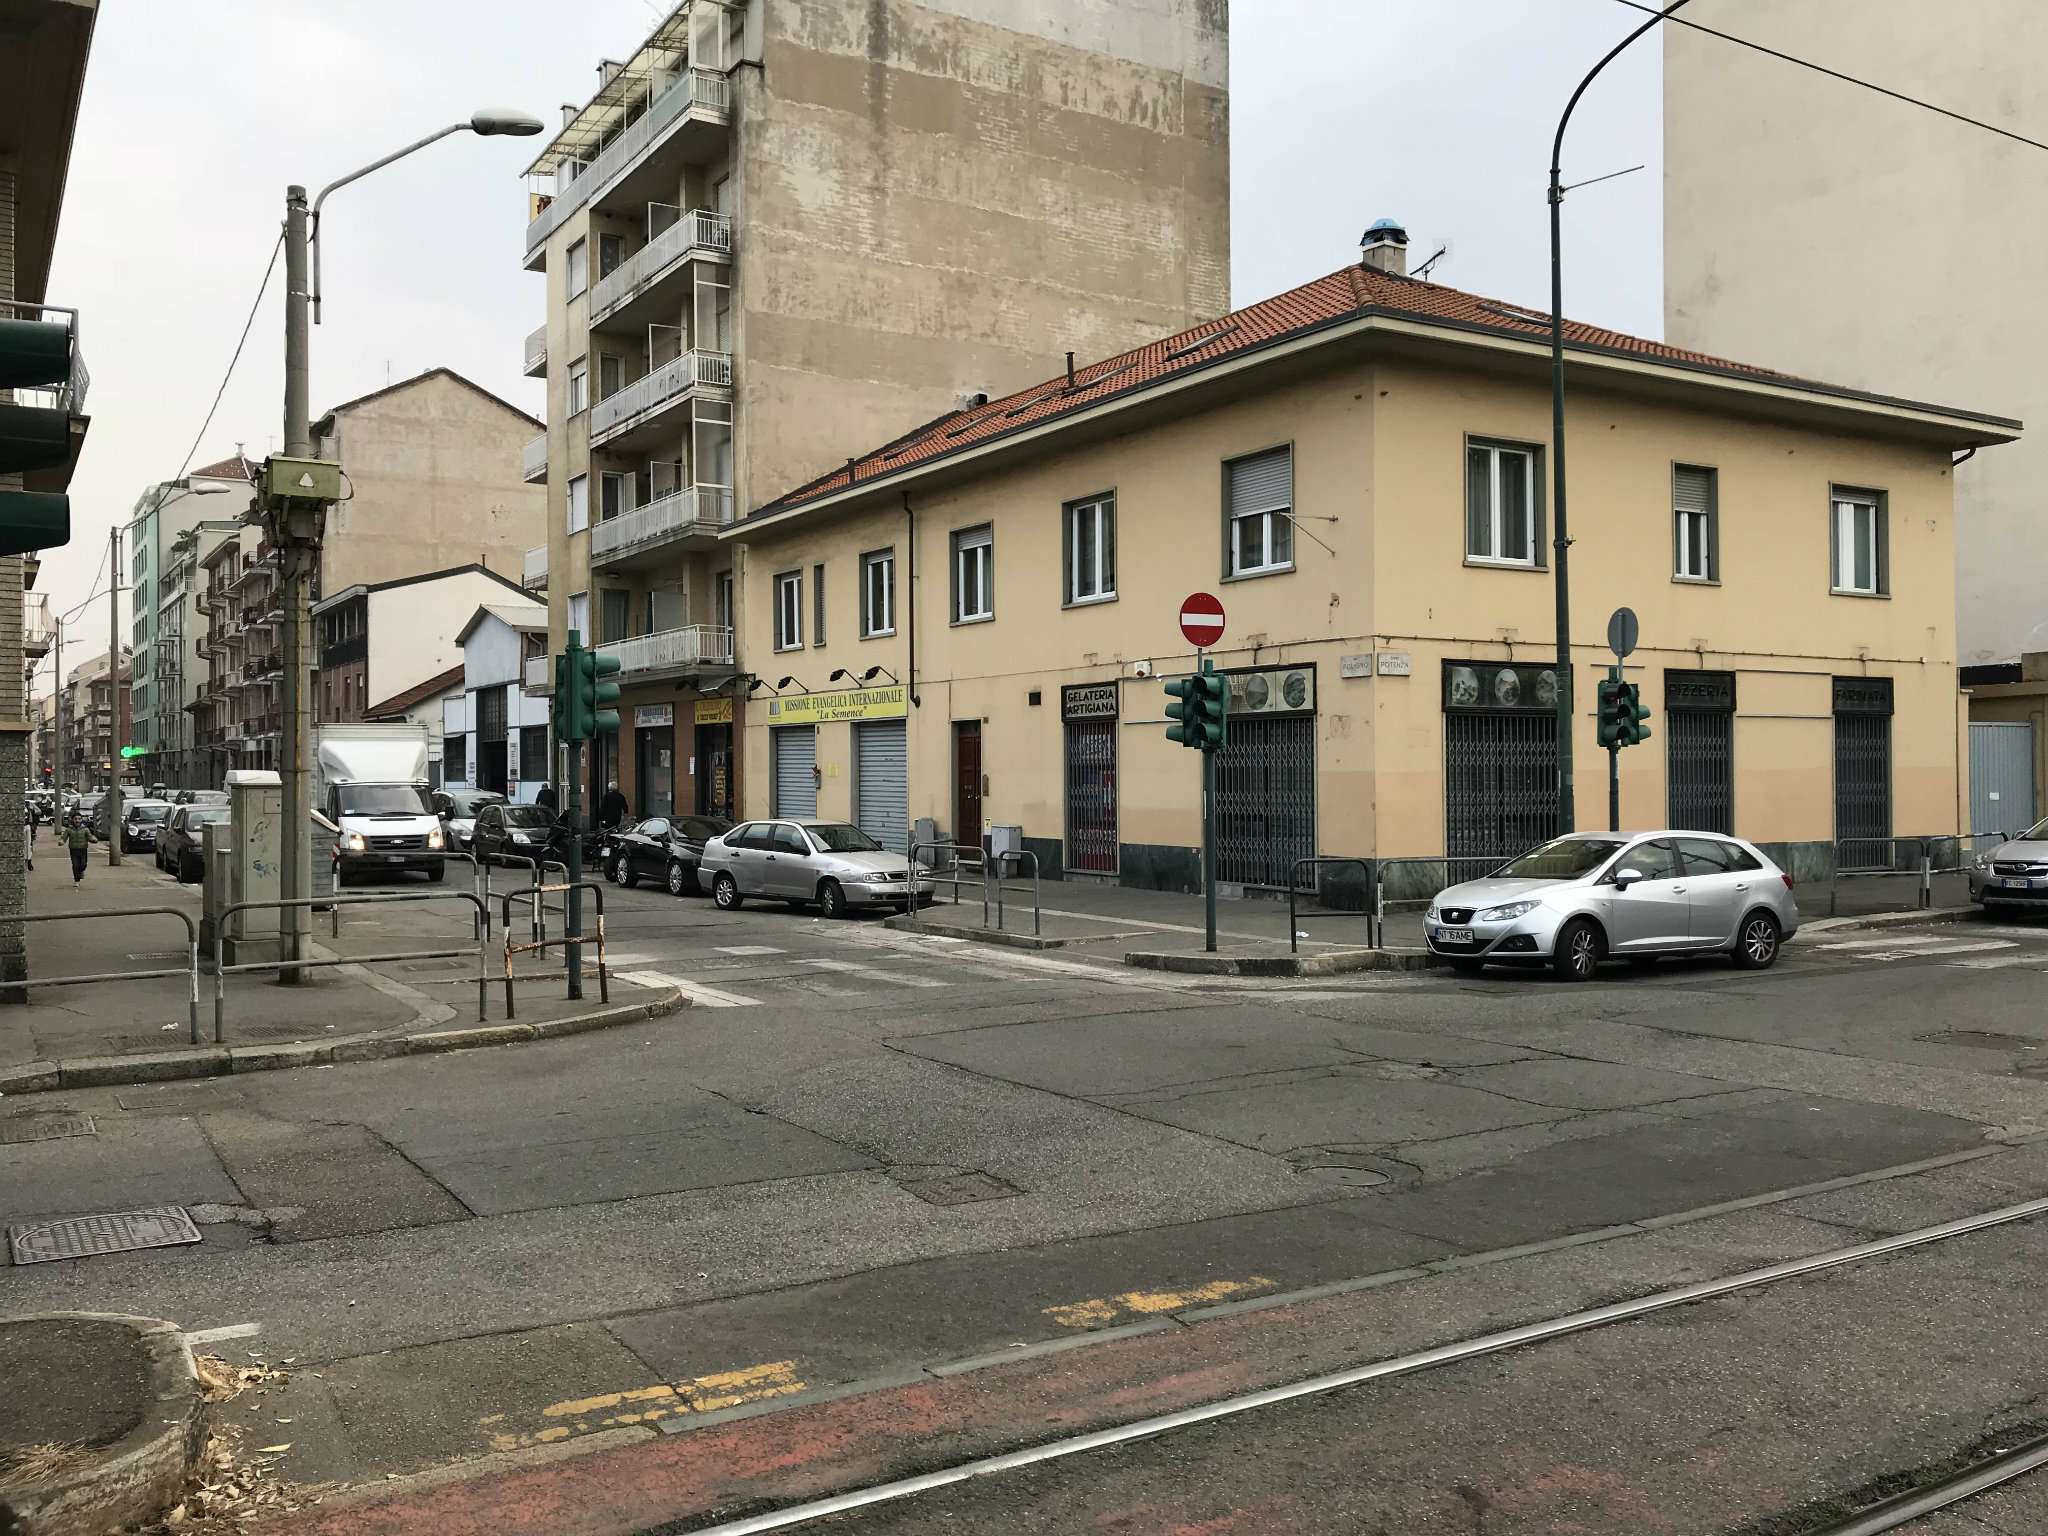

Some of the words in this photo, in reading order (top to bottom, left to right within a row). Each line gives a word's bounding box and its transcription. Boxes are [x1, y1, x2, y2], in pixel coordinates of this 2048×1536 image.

[784, 698, 811, 712] MISSIONE
[812, 695, 848, 710] EVANGELICA
[849, 689, 903, 706] INTERNAZIONALE
[1067, 689, 1114, 703] GELATERIA
[1066, 702, 1115, 715] ARTIGIANA
